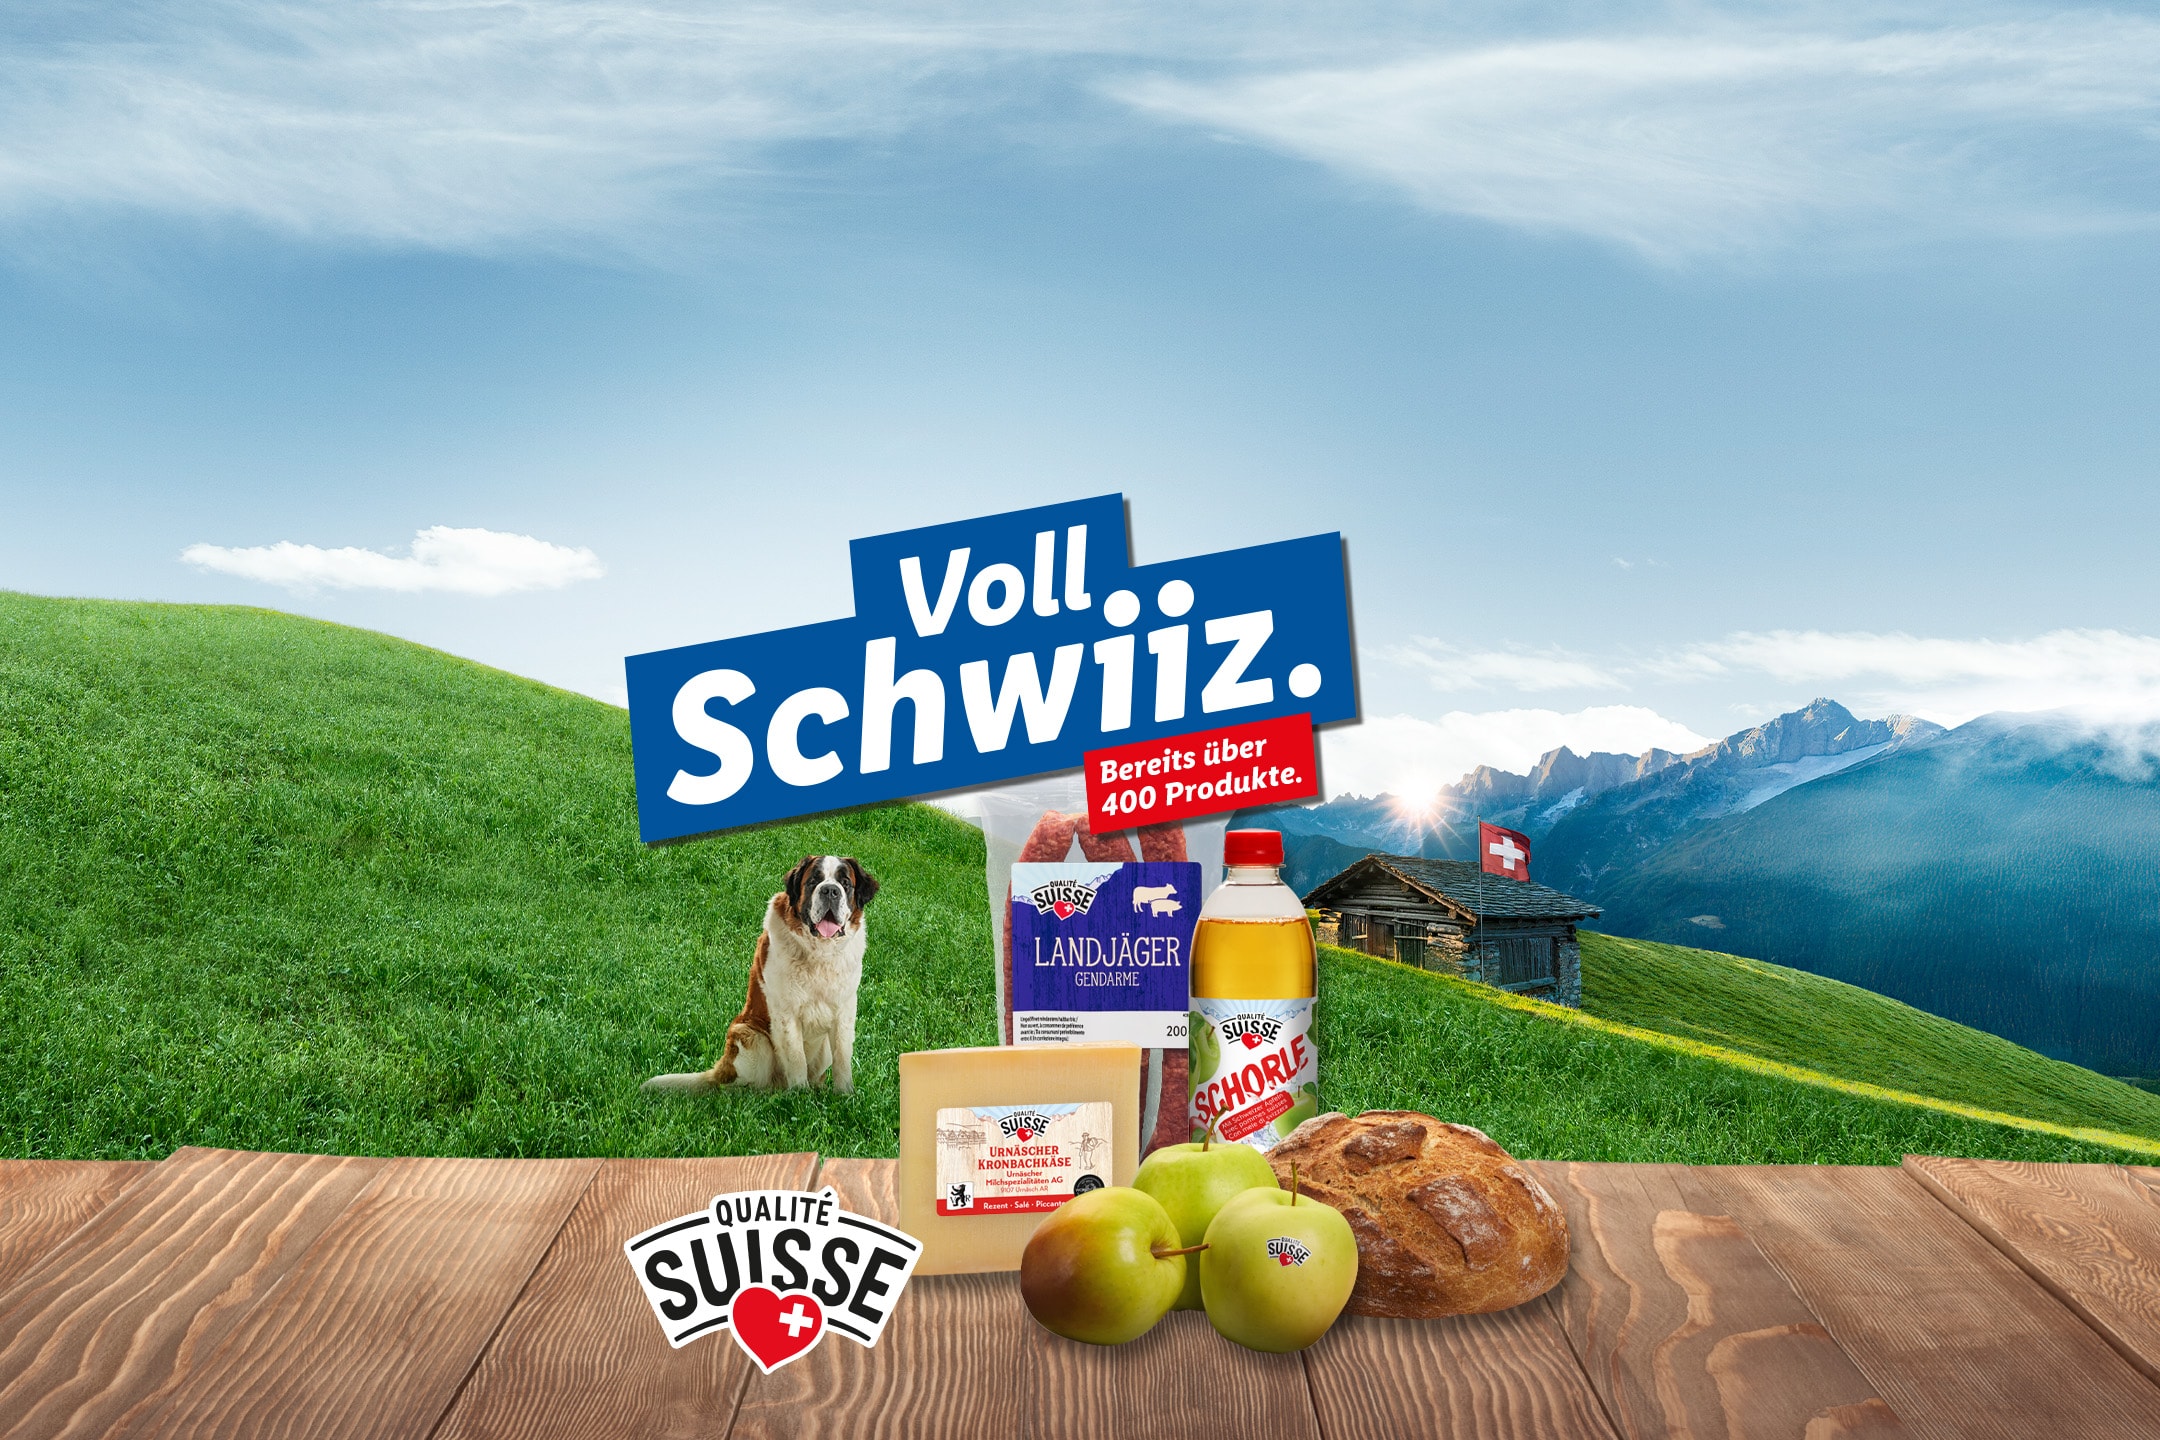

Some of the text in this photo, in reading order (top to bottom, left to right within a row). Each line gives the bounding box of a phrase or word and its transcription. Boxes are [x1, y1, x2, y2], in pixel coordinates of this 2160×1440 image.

[1049, 879, 1077, 888] QUALITÉ
[1033, 887, 1094, 910] SUISSE
[1034, 932, 1181, 967] LANDJÄGER
[1075, 971, 1140, 987] GENDARME
[1236, 1012, 1266, 1021] QUALITÉ
[1166, 1025, 1188, 1037] 200
[1222, 1020, 1282, 1041] SUISSE
[1195, 1033, 1309, 1125] SCHORLE
[1013, 1109, 1036, 1117] QUALITÉ
[1221, 1120, 1232, 1129] Mit
[1231, 1105, 1264, 1124] Schweizer
[1238, 1111, 1266, 1129] pommes
[1000, 1115, 1050, 1135] SUISSE
[1228, 1129, 1242, 1140] Con
[989, 1144, 1060, 1158] URNÄSCHER
[978, 1156, 1072, 1171] KRONBACHKÄSE
[985, 1175, 1064, 1187] Milchspezialitäten AG
[1006, 1170, 1043, 1178] Urnäscher
[1015, 1185, 1039, 1193] Urnäsch
[983, 1201, 1009, 1210] Rezent
[1014, 1200, 1030, 1209] Salé
[1268, 1242, 1309, 1264] SUISSE
